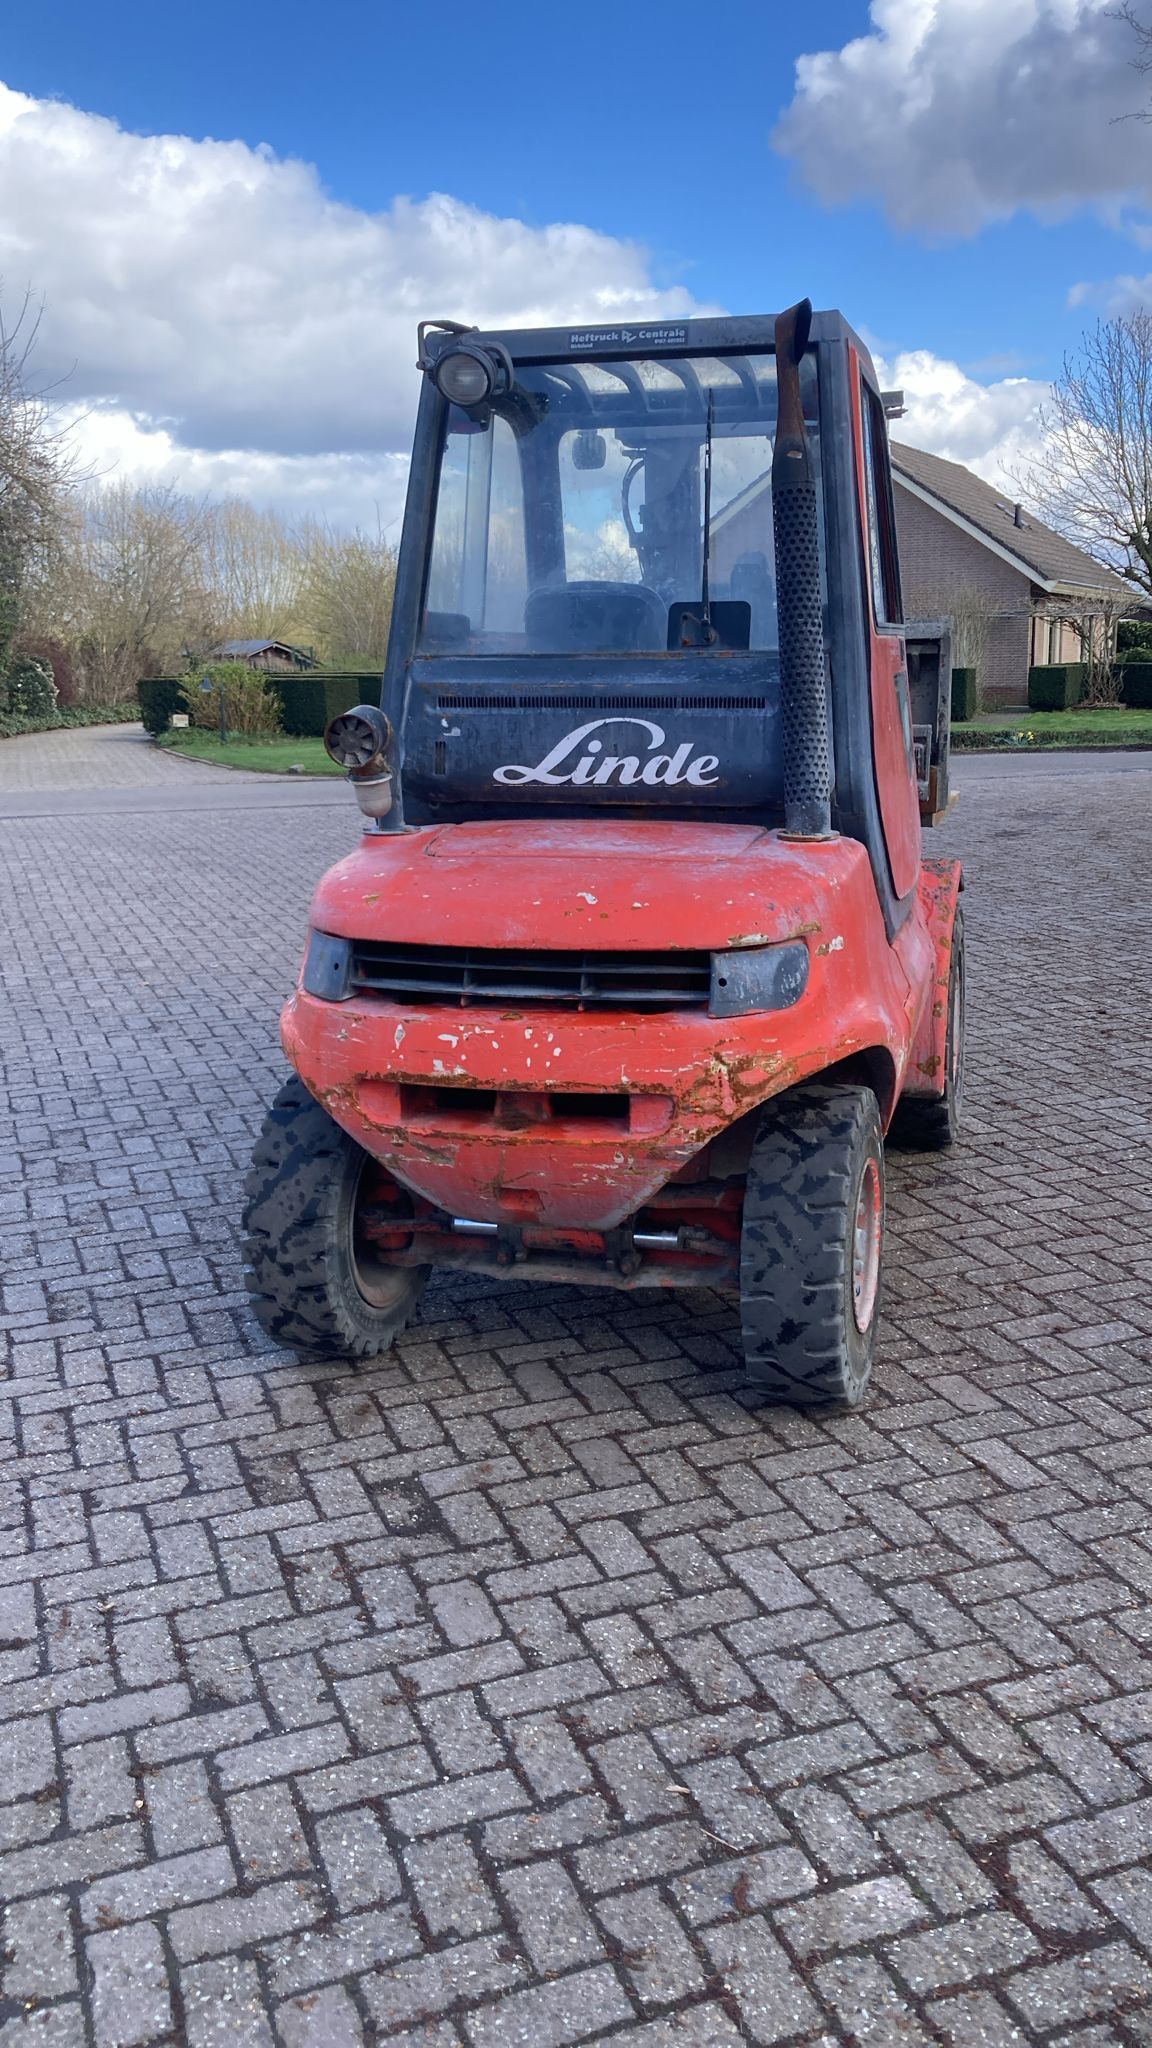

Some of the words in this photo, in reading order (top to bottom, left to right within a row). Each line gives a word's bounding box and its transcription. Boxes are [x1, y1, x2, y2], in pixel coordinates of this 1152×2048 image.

[571, 332, 619, 342] Heftruck
[639, 328, 685, 338] Centrale
[493, 717, 719, 785] Linde
